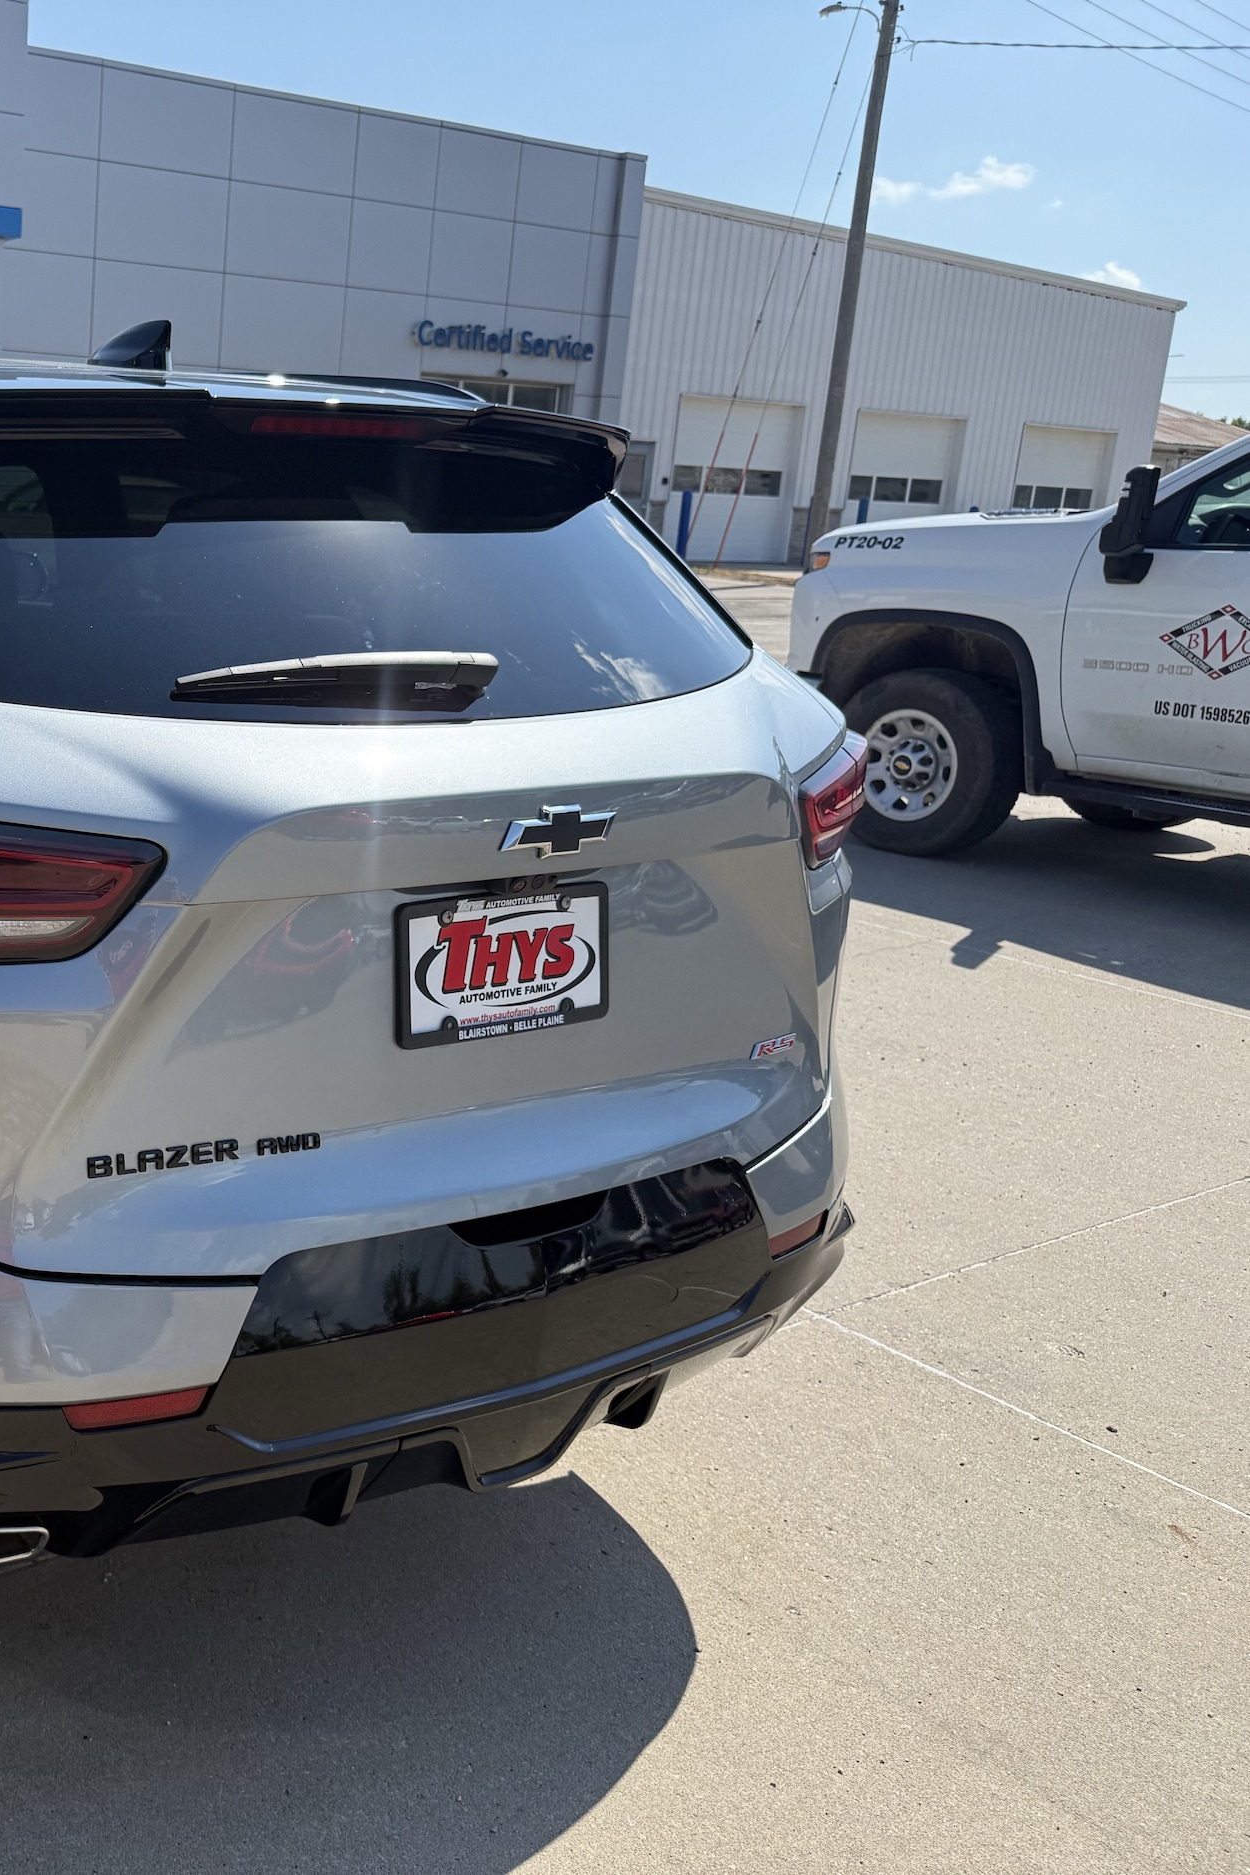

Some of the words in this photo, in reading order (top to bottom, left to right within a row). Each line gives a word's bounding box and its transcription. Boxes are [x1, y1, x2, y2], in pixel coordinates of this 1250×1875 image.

[418, 320, 513, 354] Certified
[520, 331, 594, 361] Service
[834, 536, 905, 550] PT20-02
[1153, 700, 1170, 716] US
[1172, 702, 1197, 719] DOT
[1200, 706, 1250, 725] 1598526
[485, 897, 534, 910] AUTOMOTIVE
[534, 893, 561, 904] FAMILY
[436, 916, 576, 995] THYS
[458, 987, 522, 1005] AUTOMOTIVE
[524, 982, 558, 996] FAMILY
[458, 1025, 509, 1041] BLAIRSTOWN
[513, 1020, 538, 1033] BELLE
[537, 1014, 565, 1028] PLAINE
[459, 1004, 556, 1026] www.thysautofamily.com
[749, 1032, 796, 1060] RS
[87, 1138, 240, 1179] BLAZER
[257, 1132, 321, 1156] AWD
